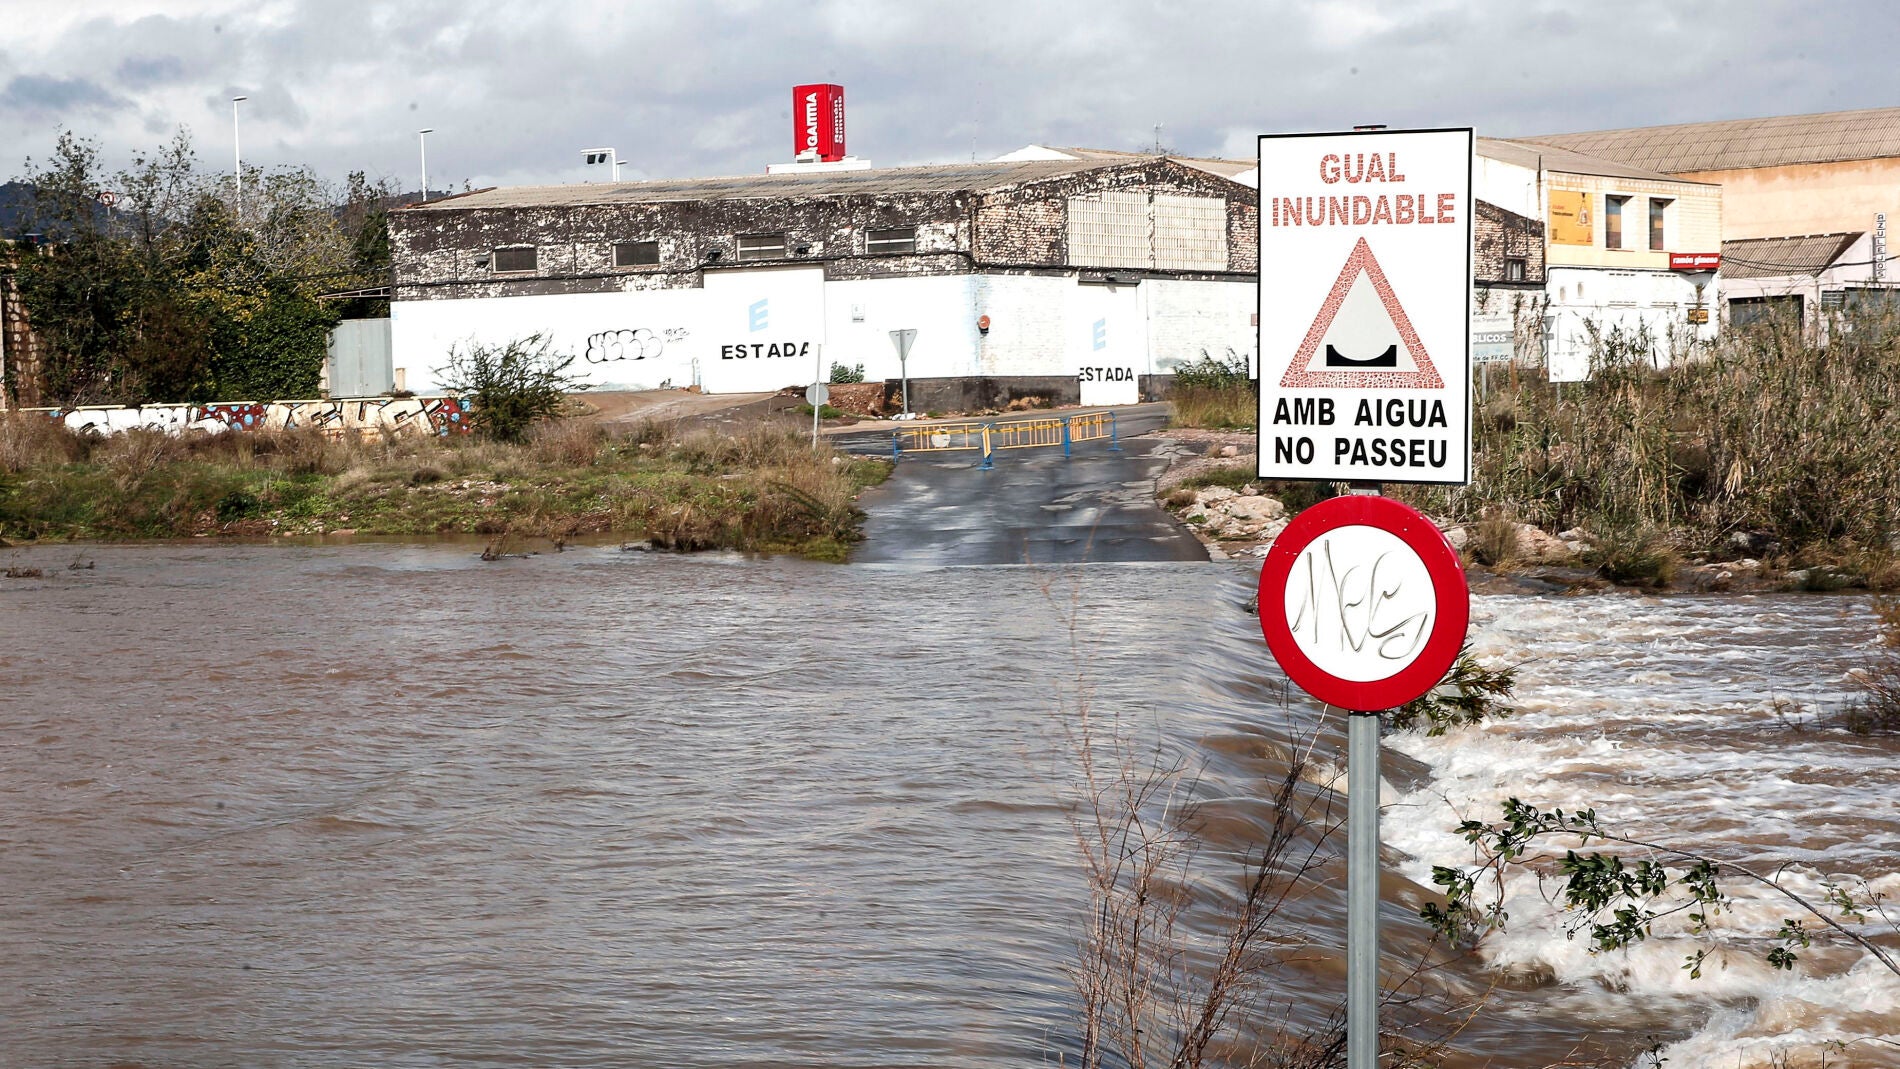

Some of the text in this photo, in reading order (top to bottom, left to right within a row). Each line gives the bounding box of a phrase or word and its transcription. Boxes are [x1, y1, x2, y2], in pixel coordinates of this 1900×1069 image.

[1319, 152, 1406, 185] GUAL
[1272, 193, 1456, 227] INUNDABLE
[721, 342, 809, 360] ESTADA
[1079, 366, 1134, 382] ESTADA
[1273, 398, 1448, 428] AMB AIGUA
[1275, 436, 1448, 468] NO PASSEU
